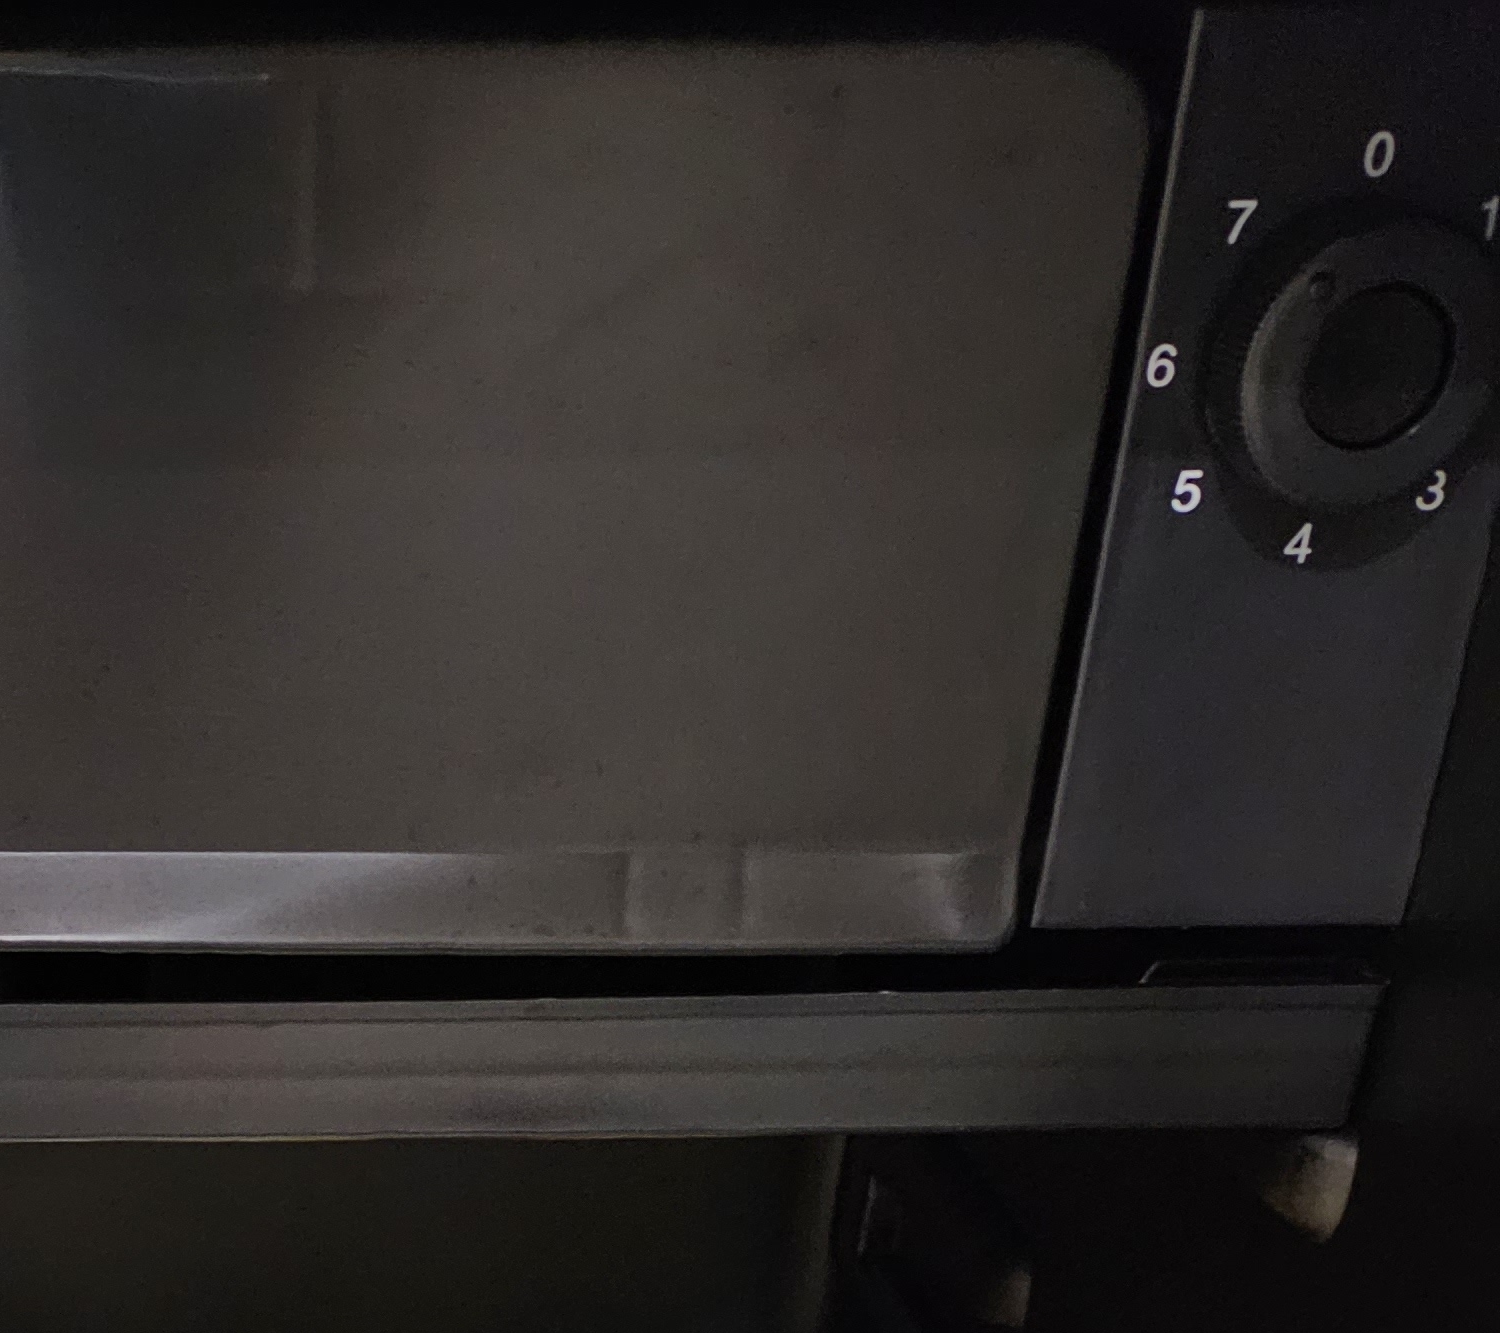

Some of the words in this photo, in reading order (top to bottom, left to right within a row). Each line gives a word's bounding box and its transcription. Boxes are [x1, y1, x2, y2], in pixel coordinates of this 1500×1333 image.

[1364, 131, 1395, 177] 0
[1227, 200, 1258, 244] 7
[1482, 195, 1500, 240] 1
[1146, 344, 1178, 388] 6
[1171, 470, 1203, 513] 5
[1415, 470, 1447, 511] 3
[1283, 523, 1313, 564] 4
